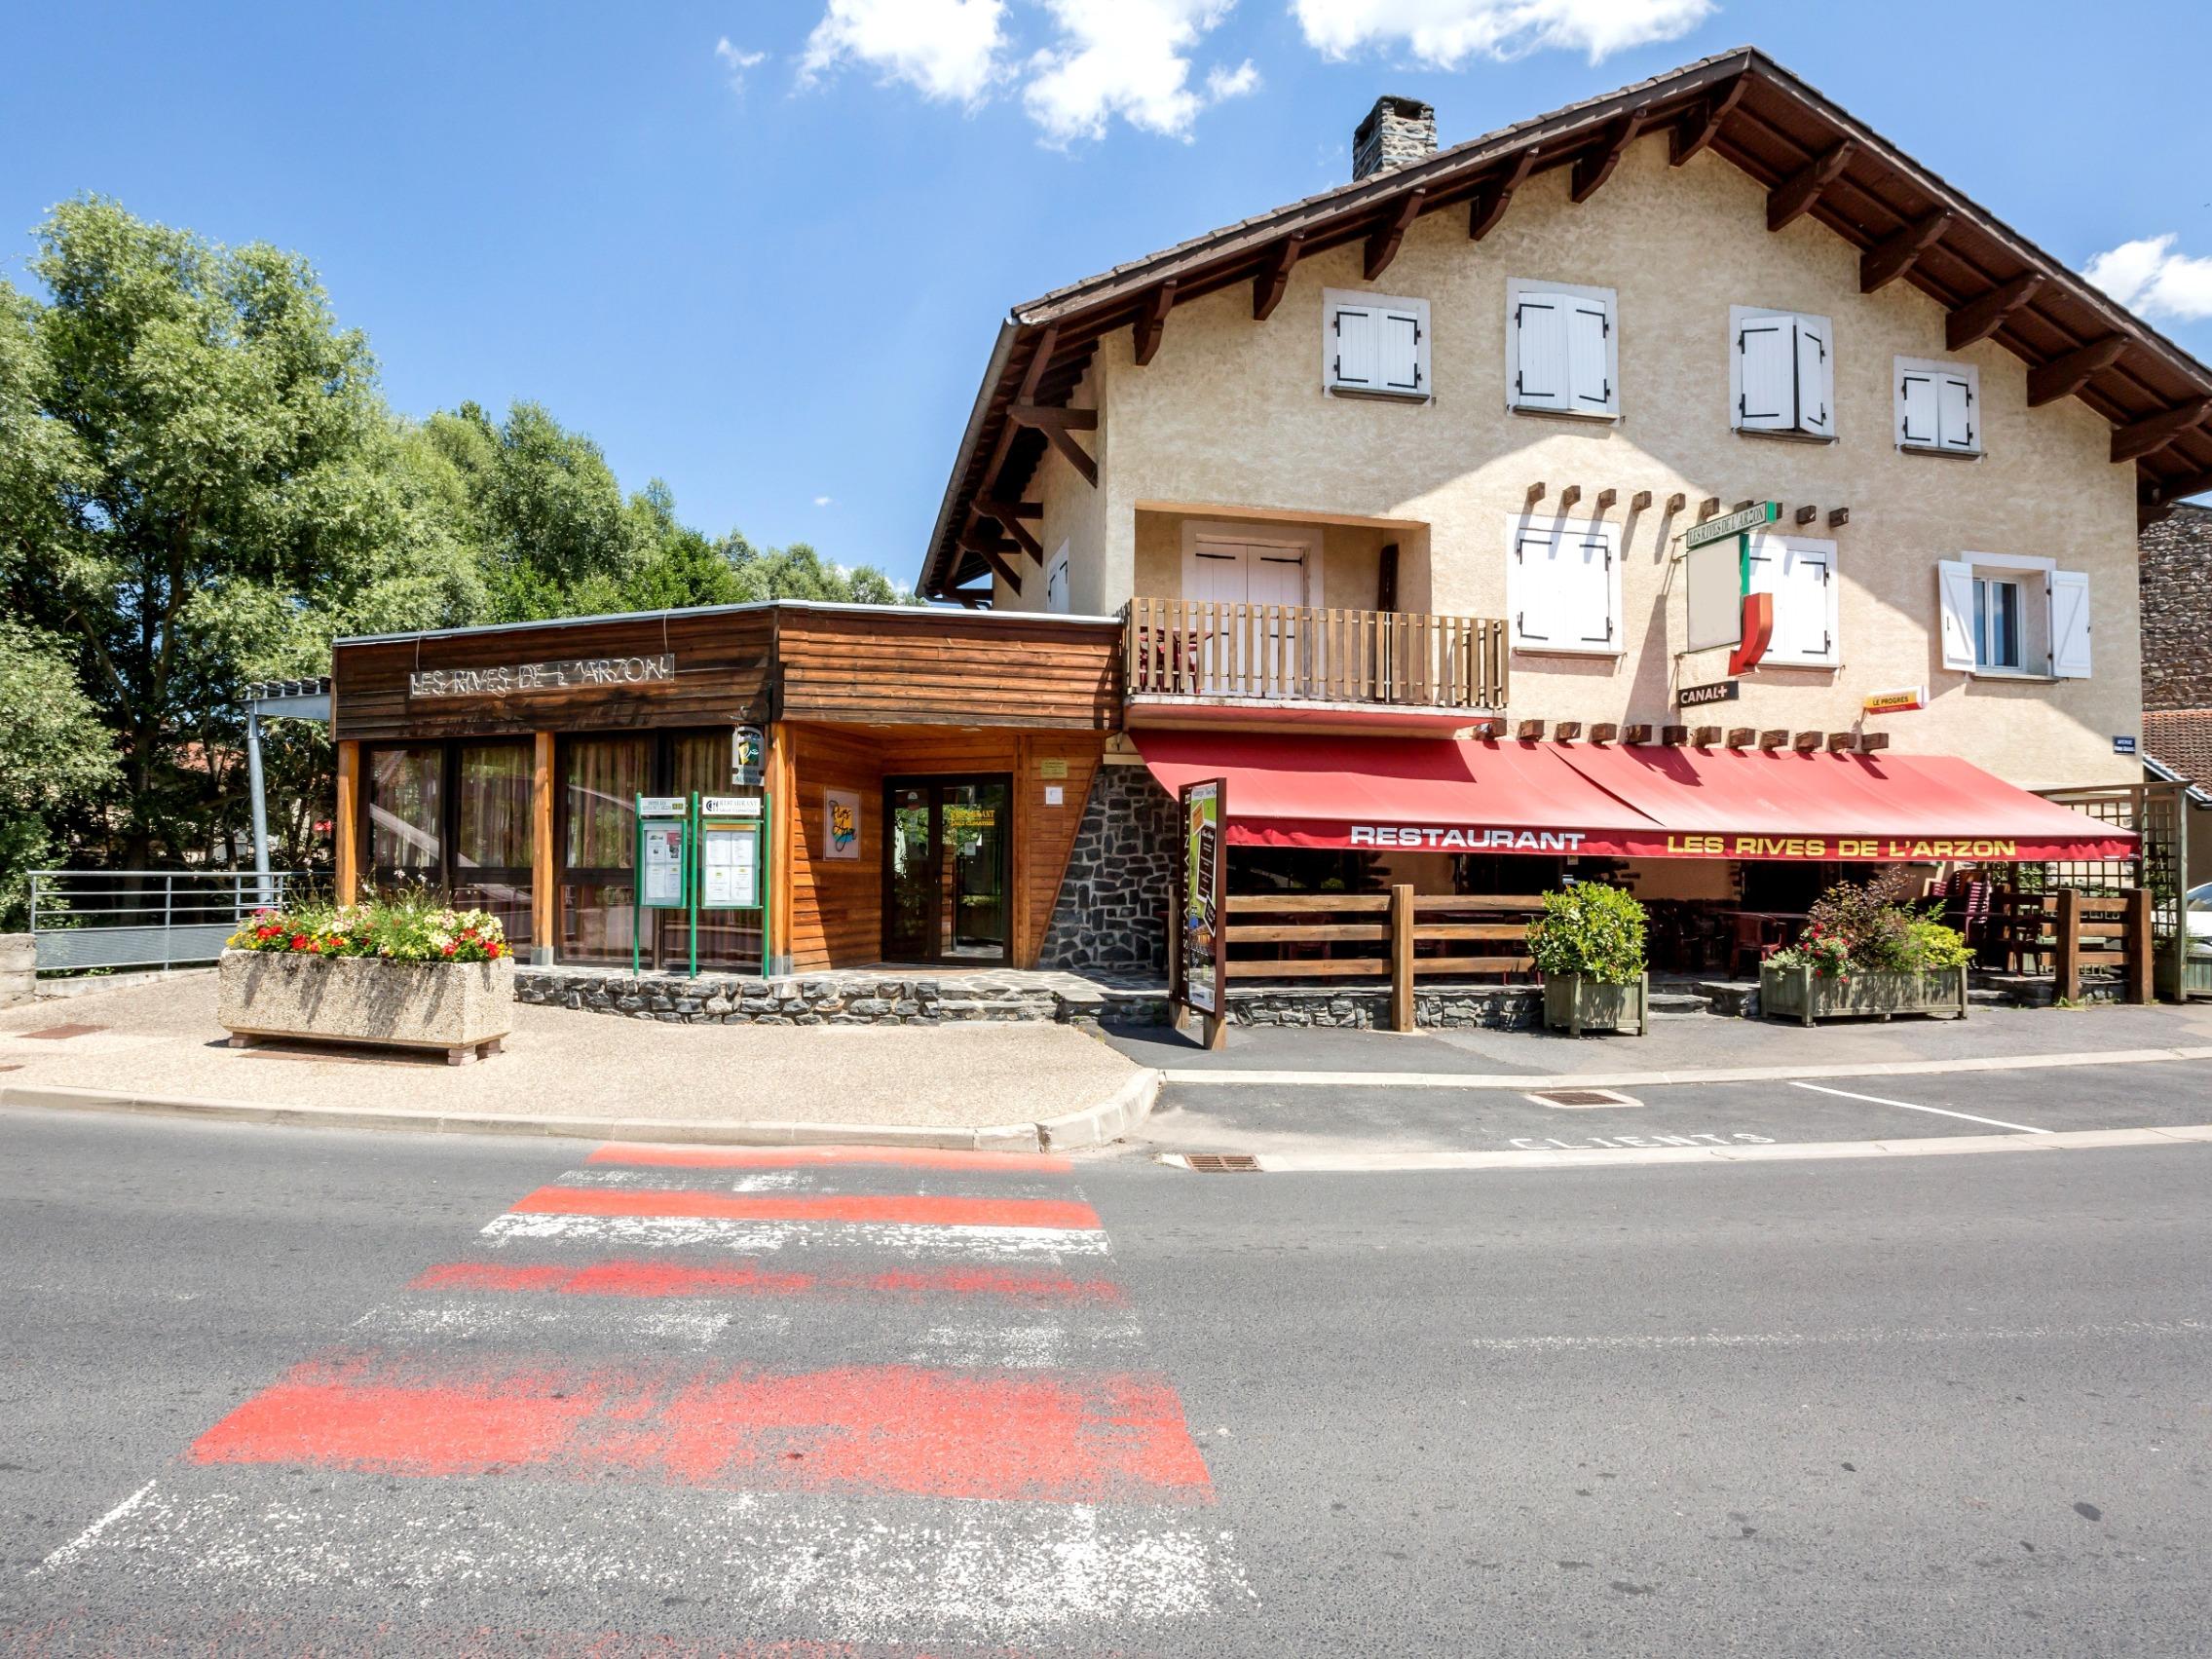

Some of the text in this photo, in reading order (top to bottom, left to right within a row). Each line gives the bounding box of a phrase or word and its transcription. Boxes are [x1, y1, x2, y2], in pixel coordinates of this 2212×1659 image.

[1689, 529, 1702, 544] LES
[1702, 522, 1721, 539] RIVES
[1721, 519, 1731, 533] DE
[410, 671, 446, 696] LES
[454, 666, 508, 697] RIVES
[519, 663, 544, 689] DE
[1680, 685, 1728, 704] CANAL+
[1351, 825, 1585, 850] RESTAURANT
[1667, 836, 2016, 857] LES RIVES DE L'ARZON
[1510, 1133, 1776, 1150] CLIENTS
